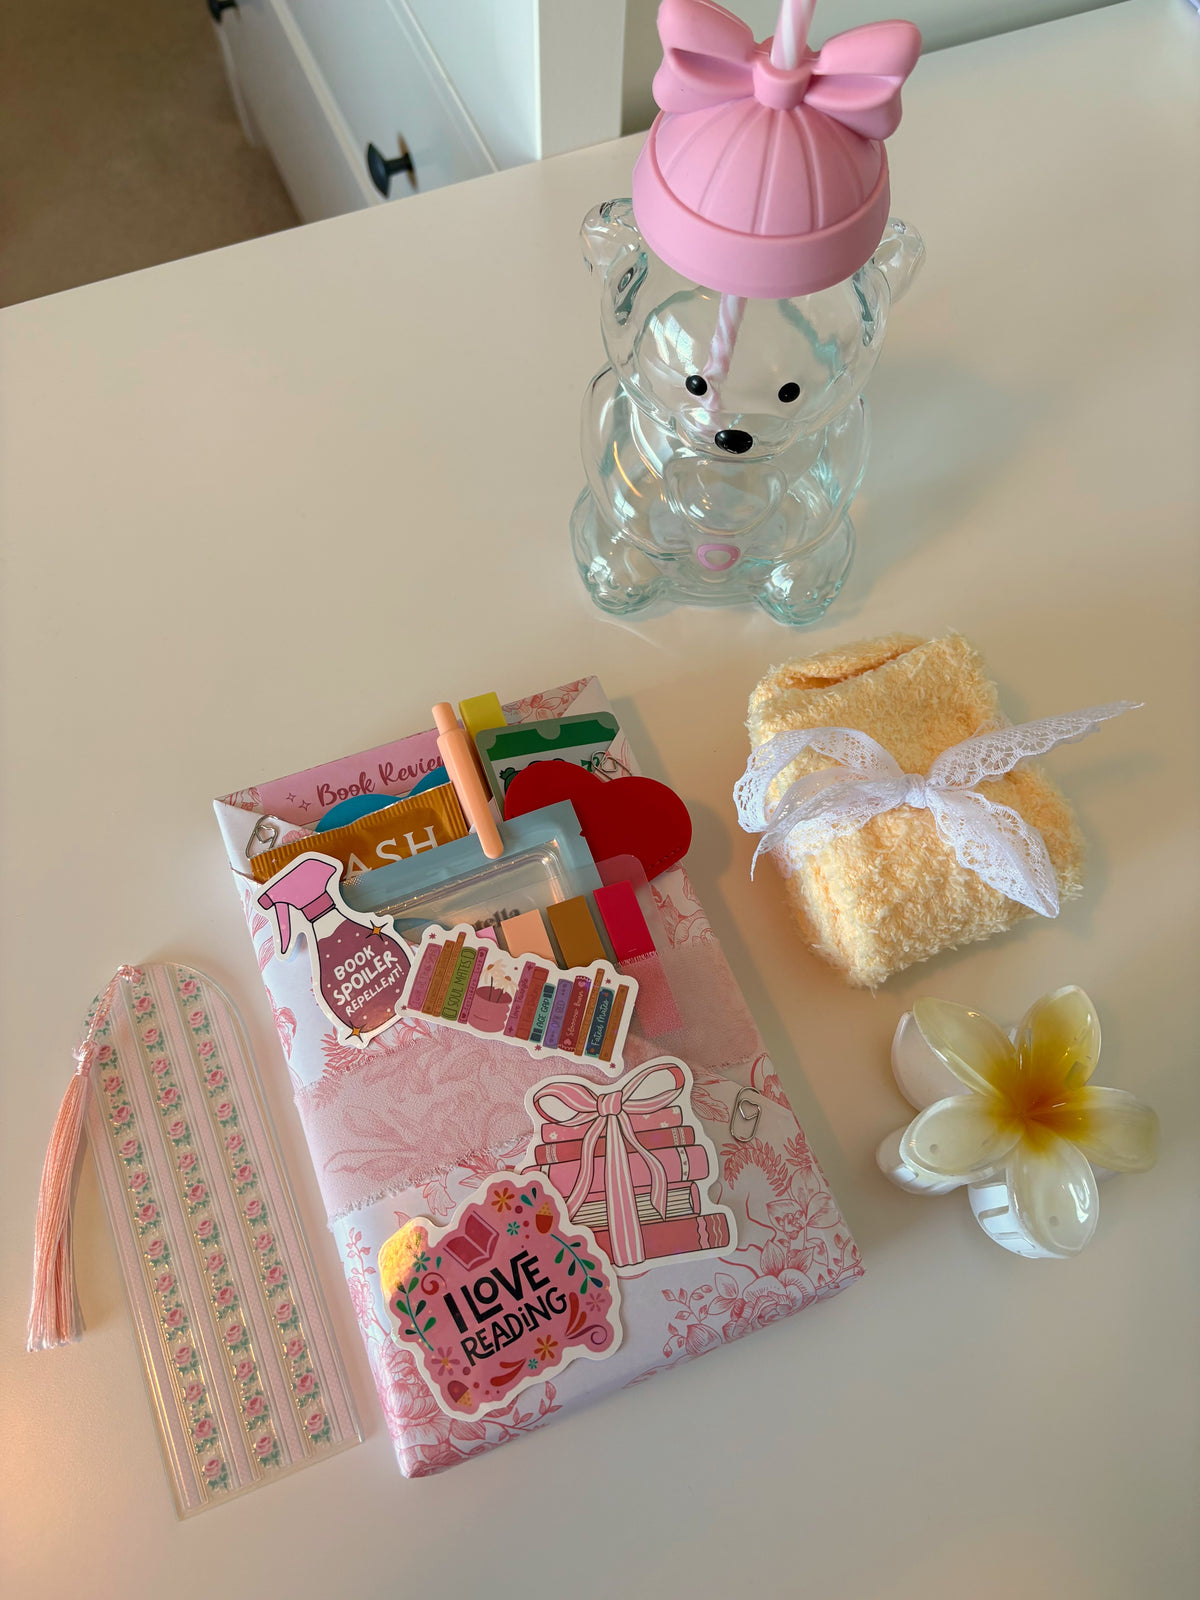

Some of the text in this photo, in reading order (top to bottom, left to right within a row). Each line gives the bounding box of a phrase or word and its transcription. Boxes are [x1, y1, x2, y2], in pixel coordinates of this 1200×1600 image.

[316, 771, 376, 807] Book
[333, 945, 375, 981] BOOK
[333, 951, 398, 1006] SPOILER
[454, 960, 471, 985] MATES
[345, 963, 405, 1017] REPELLENT!
[448, 987, 463, 1007] SOUL
[536, 998, 550, 1028] AGE GAP
[590, 998, 610, 1046] Fated Mates
[443, 1250, 551, 1334] I LOVE
